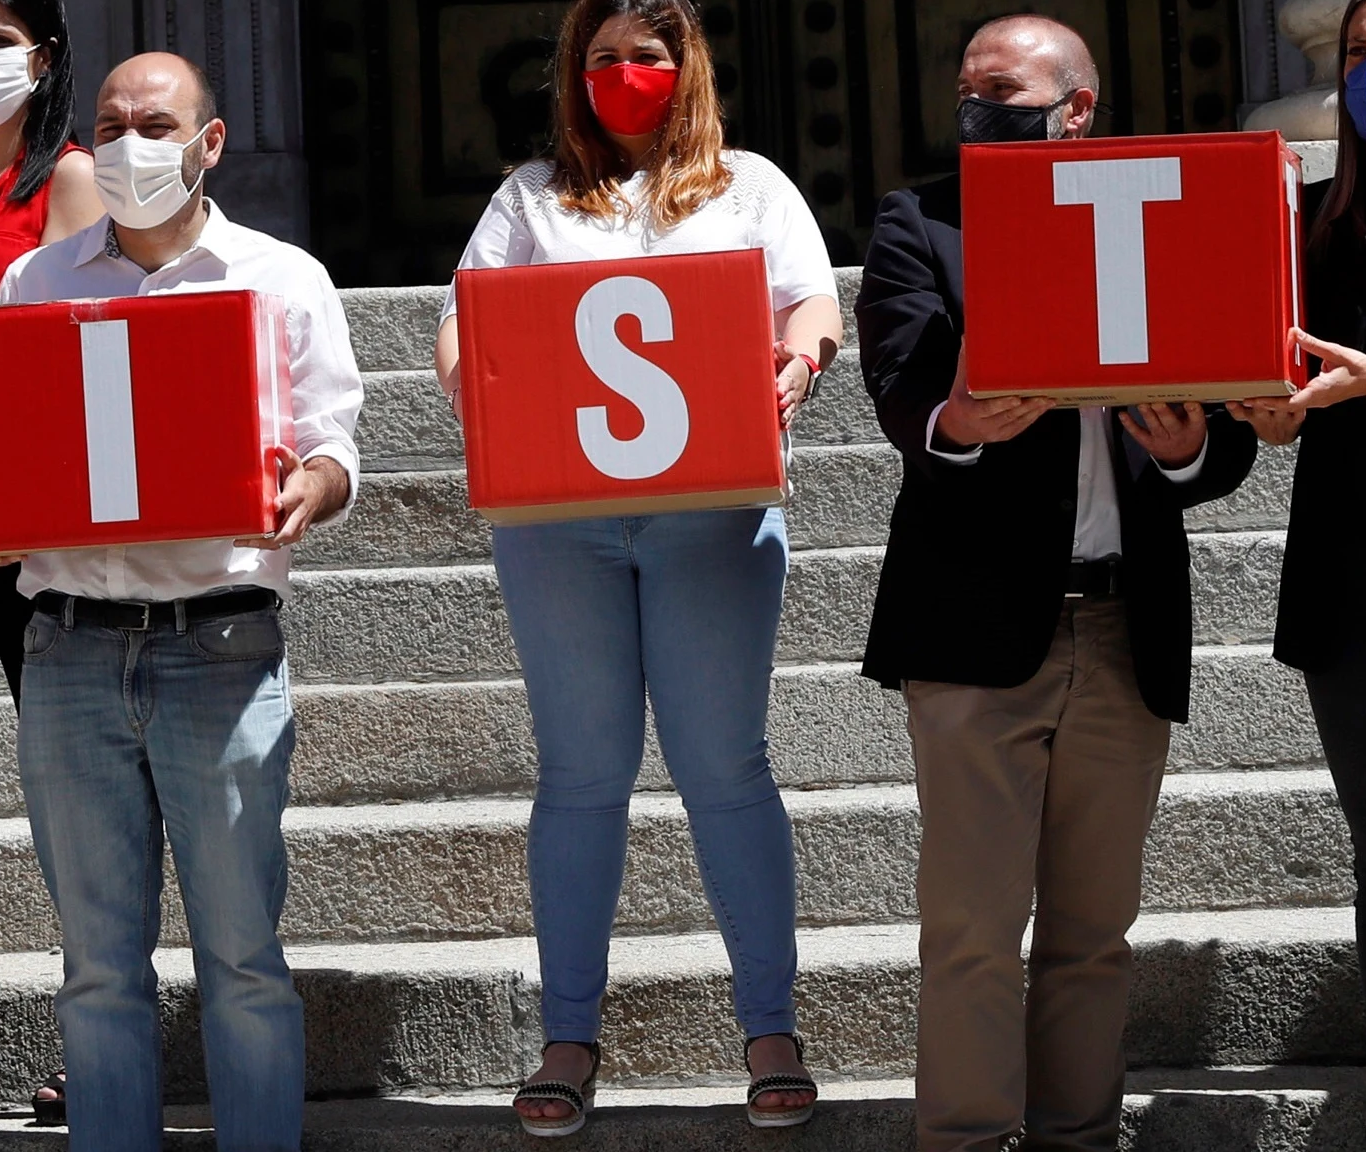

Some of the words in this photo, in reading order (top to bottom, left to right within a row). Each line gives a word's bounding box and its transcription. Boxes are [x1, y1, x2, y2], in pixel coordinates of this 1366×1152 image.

[1052, 156, 1182, 365] T
[79, 319, 140, 523] I
[574, 275, 690, 480] S
